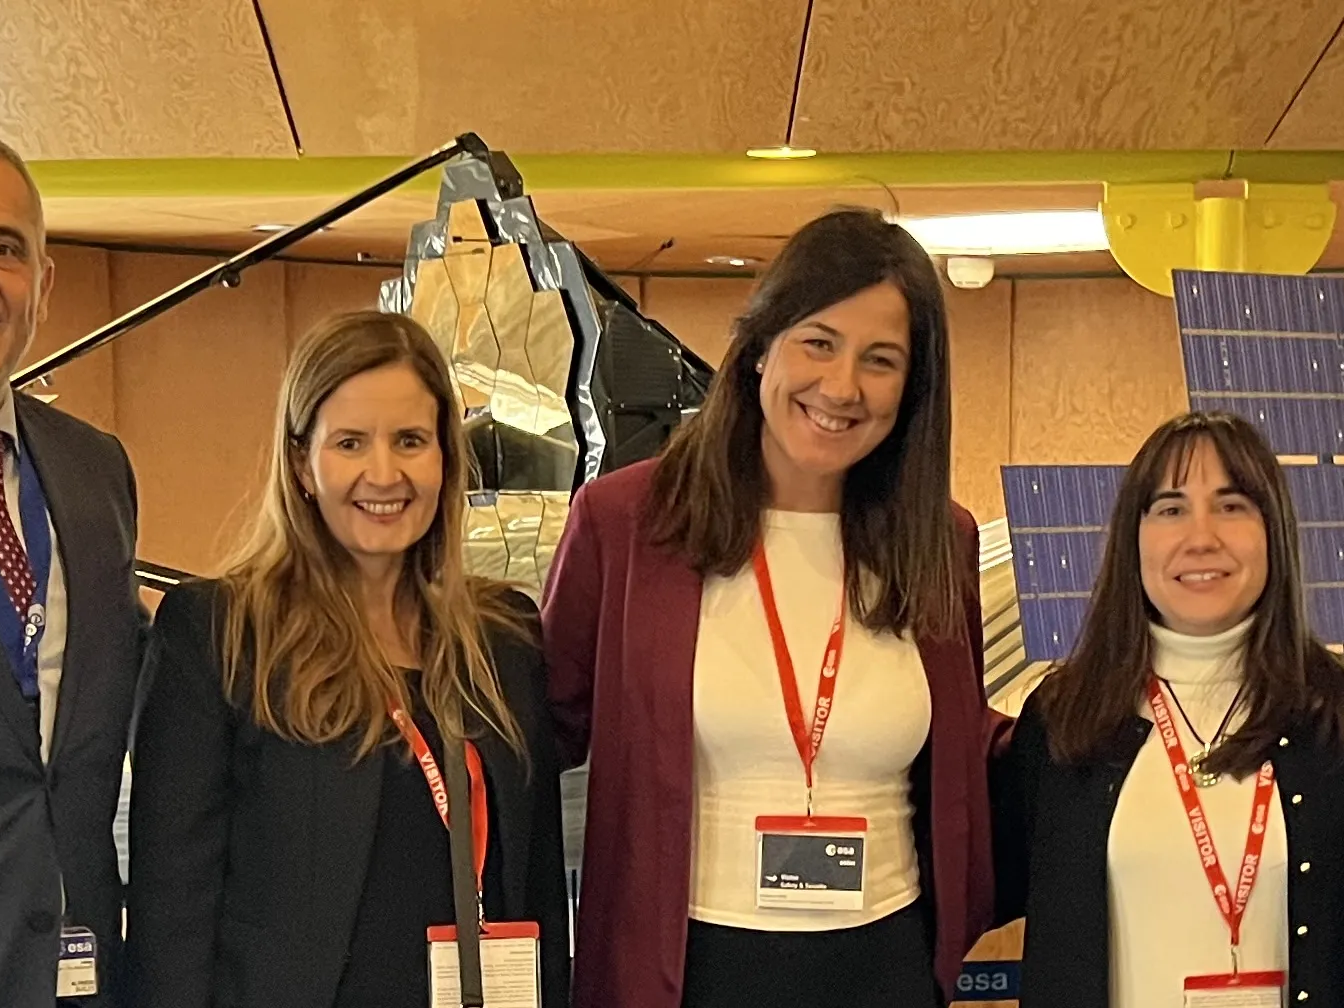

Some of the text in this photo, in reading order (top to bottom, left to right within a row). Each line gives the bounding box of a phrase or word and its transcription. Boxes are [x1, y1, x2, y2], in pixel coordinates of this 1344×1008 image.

[1152, 693, 1178, 750] VISITOR
[1188, 806, 1218, 868] VISITOR
[1234, 854, 1259, 915] VISITOR
[67, 941, 93, 953] esa
[956, 972, 1008, 992] esa
